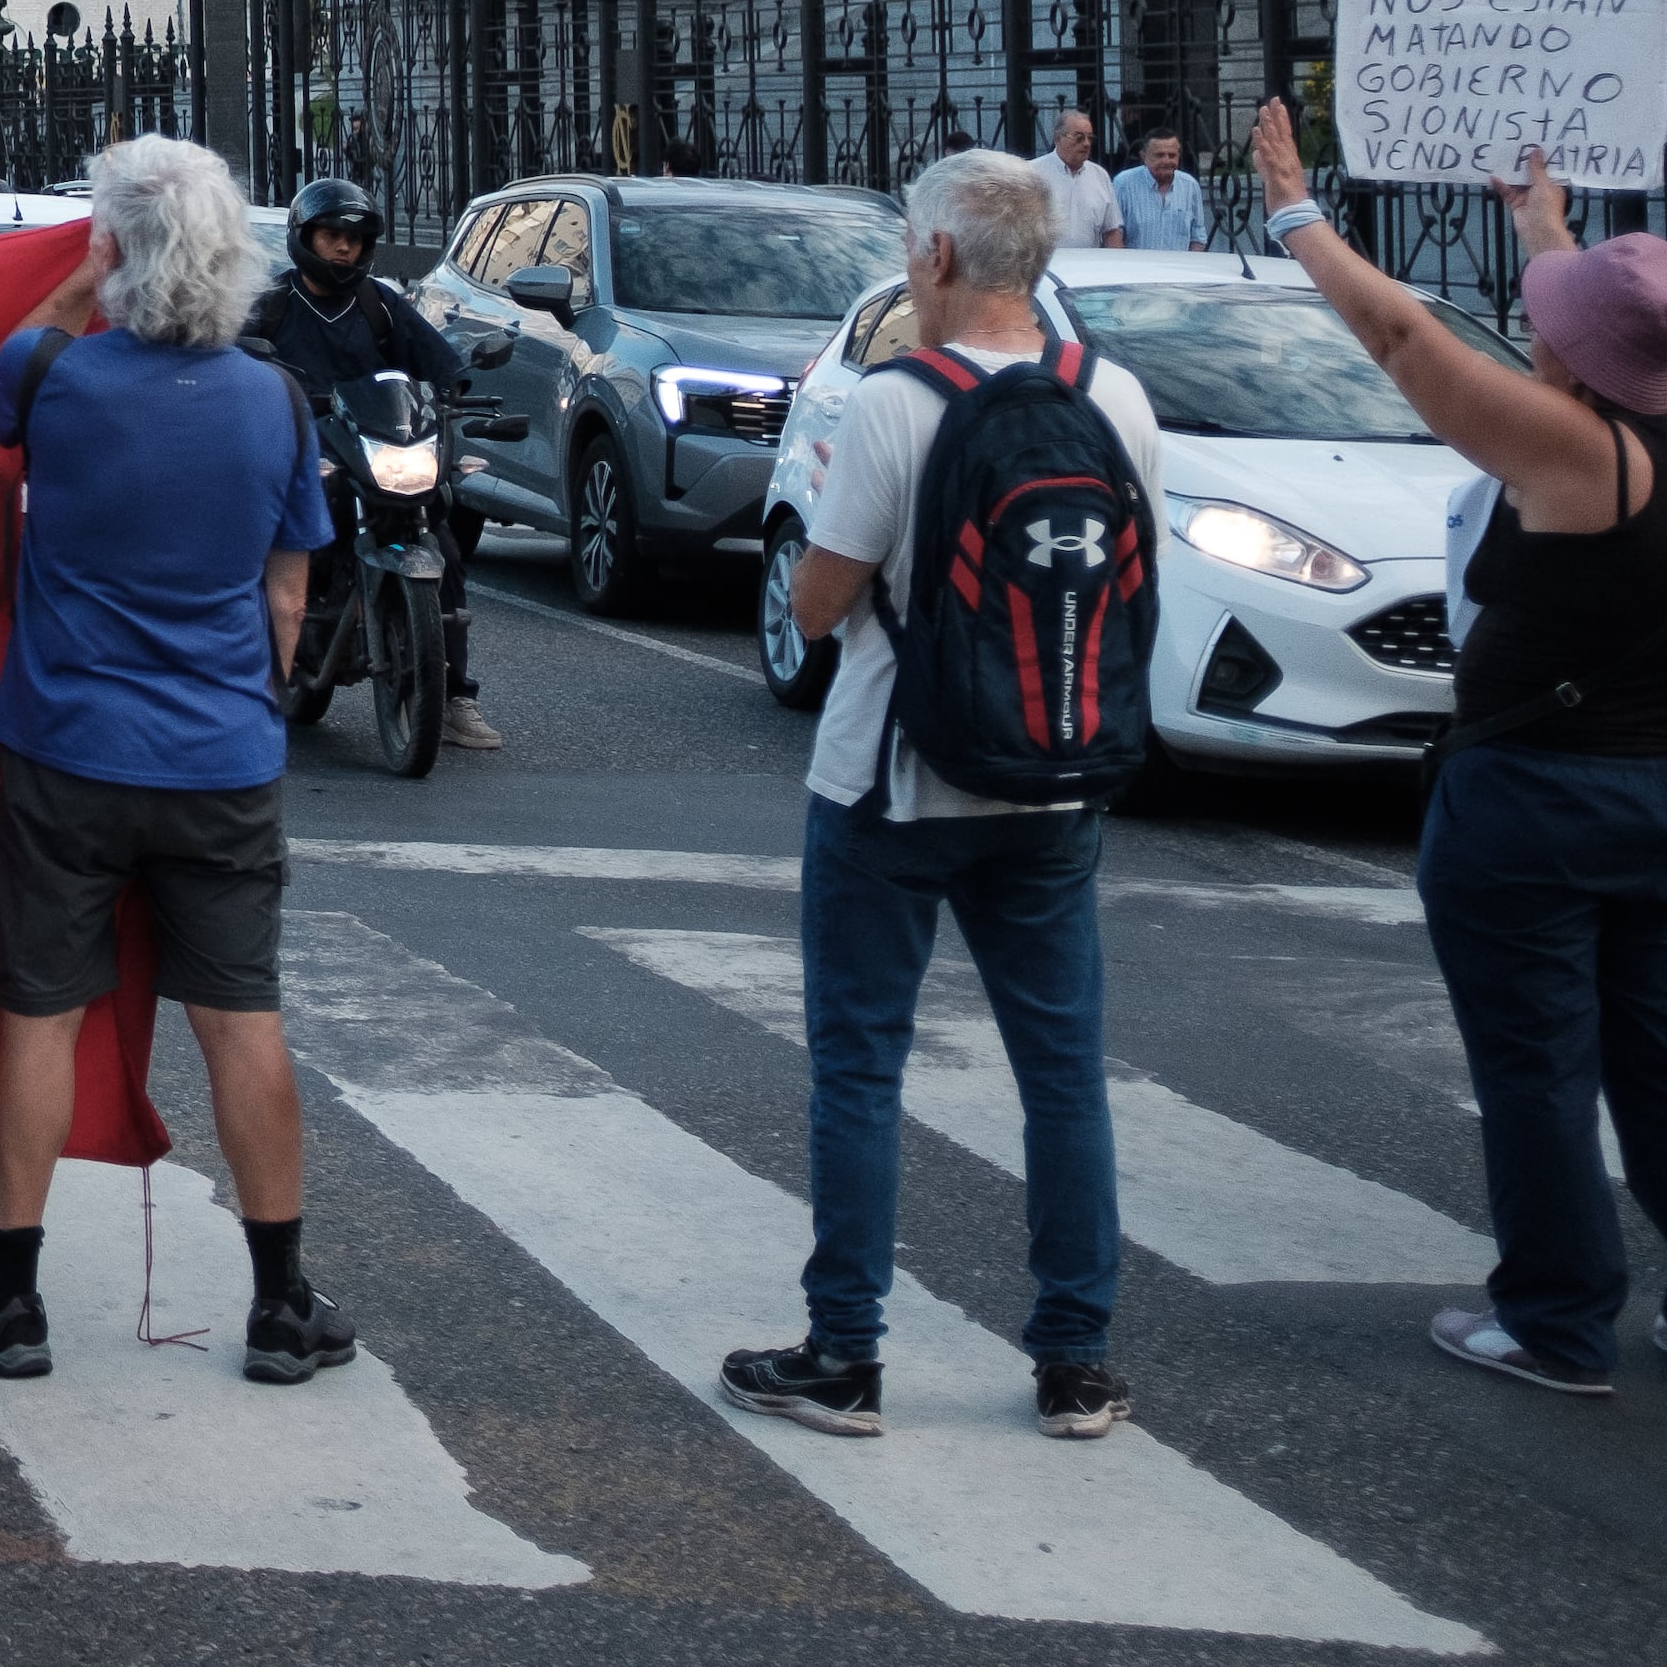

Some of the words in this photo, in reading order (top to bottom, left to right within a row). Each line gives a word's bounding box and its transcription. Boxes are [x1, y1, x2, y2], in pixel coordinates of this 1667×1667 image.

[1363, 21, 1572, 57] MATANDO
[1355, 62, 1624, 103] GOBIERNO
[1361, 99, 1591, 142] SIONISTA
[1364, 138, 1497, 174] VENDE
[1513, 141, 1647, 177] PATRIA
[1062, 591, 1077, 655] UNDER
[1061, 656, 1075, 740] ARMOUR
